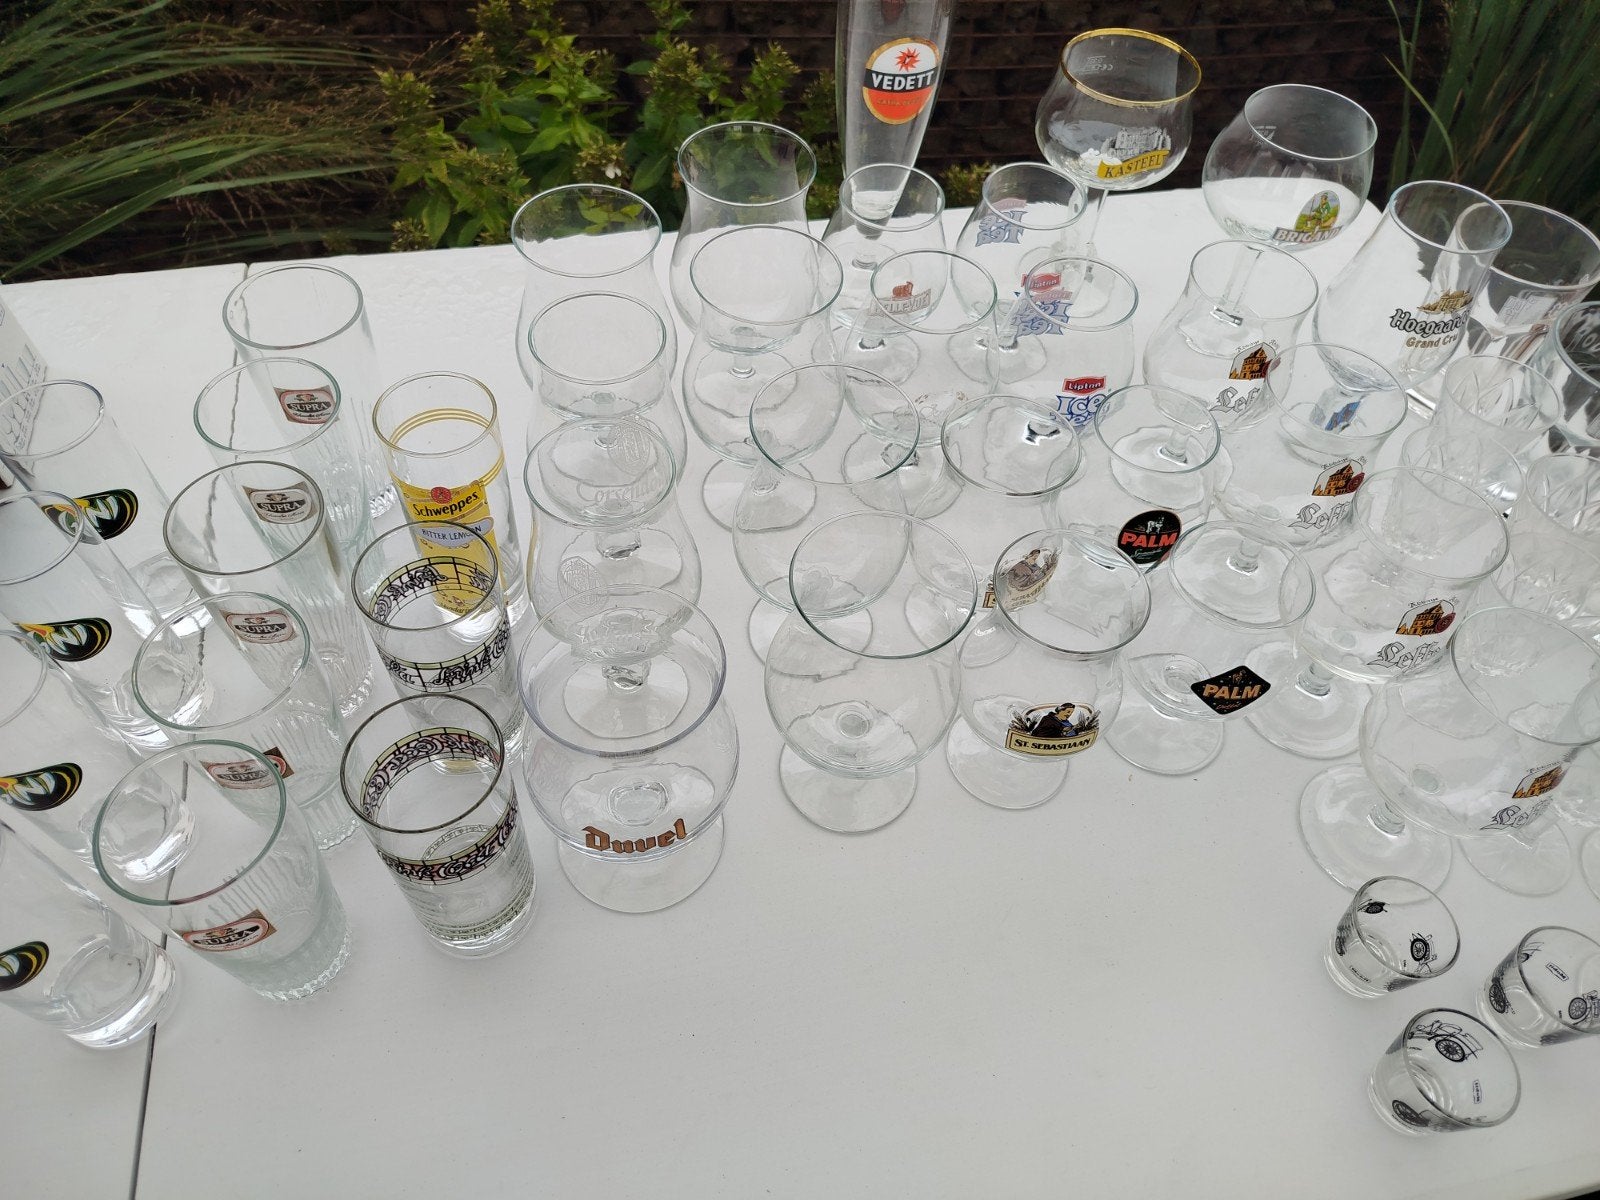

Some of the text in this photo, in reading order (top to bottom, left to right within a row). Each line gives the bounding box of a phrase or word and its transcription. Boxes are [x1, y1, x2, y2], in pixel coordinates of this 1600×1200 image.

[871, 71, 935, 91] VEDETT
[1104, 154, 1163, 178] KASTEEL
[1276, 227, 1341, 243] BRIGAND
[1406, 336, 1442, 348] Grand
[1068, 380, 1102, 392] Lipton
[291, 401, 331, 412] SUPRA
[260, 501, 301, 513] SUPRA
[413, 491, 479, 517] Schweppes
[1121, 531, 1178, 548] PALM
[237, 623, 282, 635] SUPRA
[1202, 684, 1261, 699] PALM
[1014, 737, 1091, 751] ST. SEBASTIAAN
[581, 818, 687, 853] Duvel
